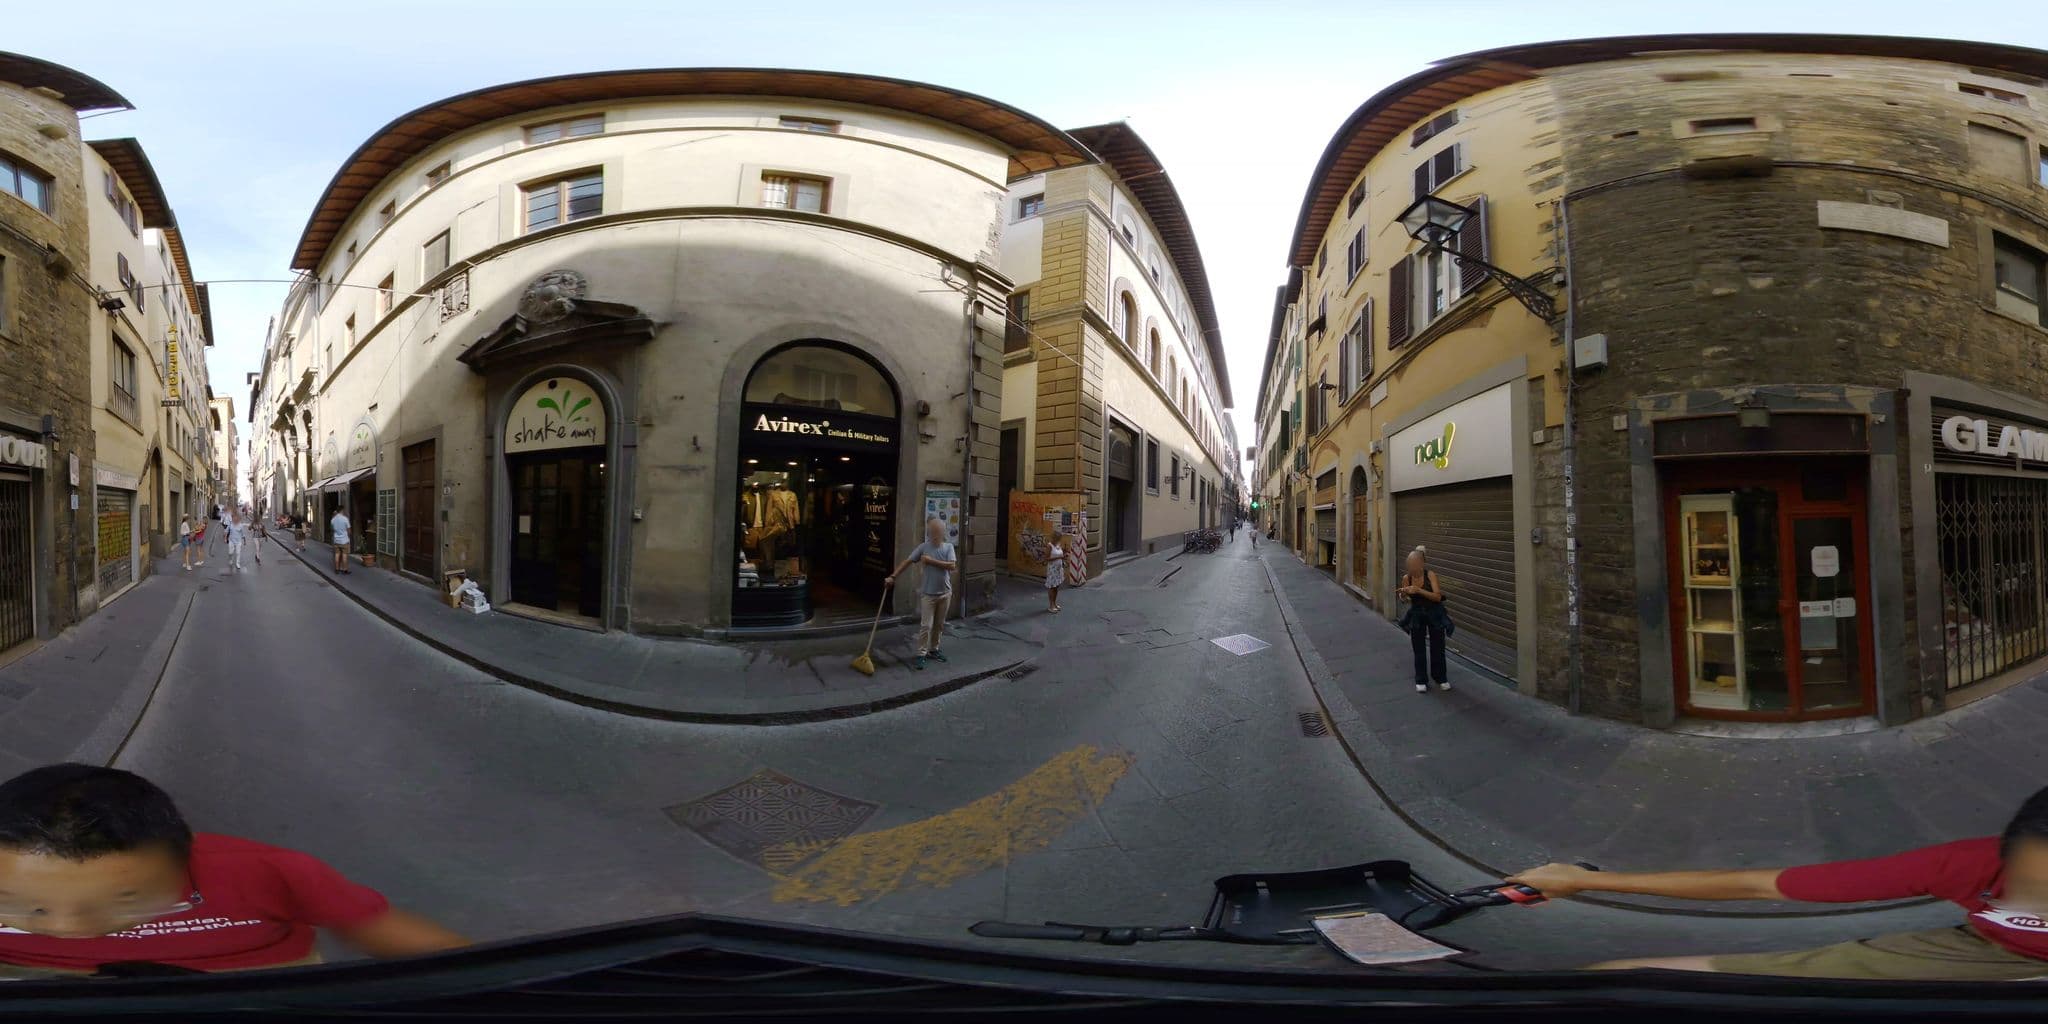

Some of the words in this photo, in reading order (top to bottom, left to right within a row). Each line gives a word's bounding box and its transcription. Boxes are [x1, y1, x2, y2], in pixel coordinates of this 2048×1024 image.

[515, 414, 566, 444] shake
[571, 427, 597, 442] away
[1941, 416, 2048, 462] GLAM
[2, 435, 48, 469] OUR
